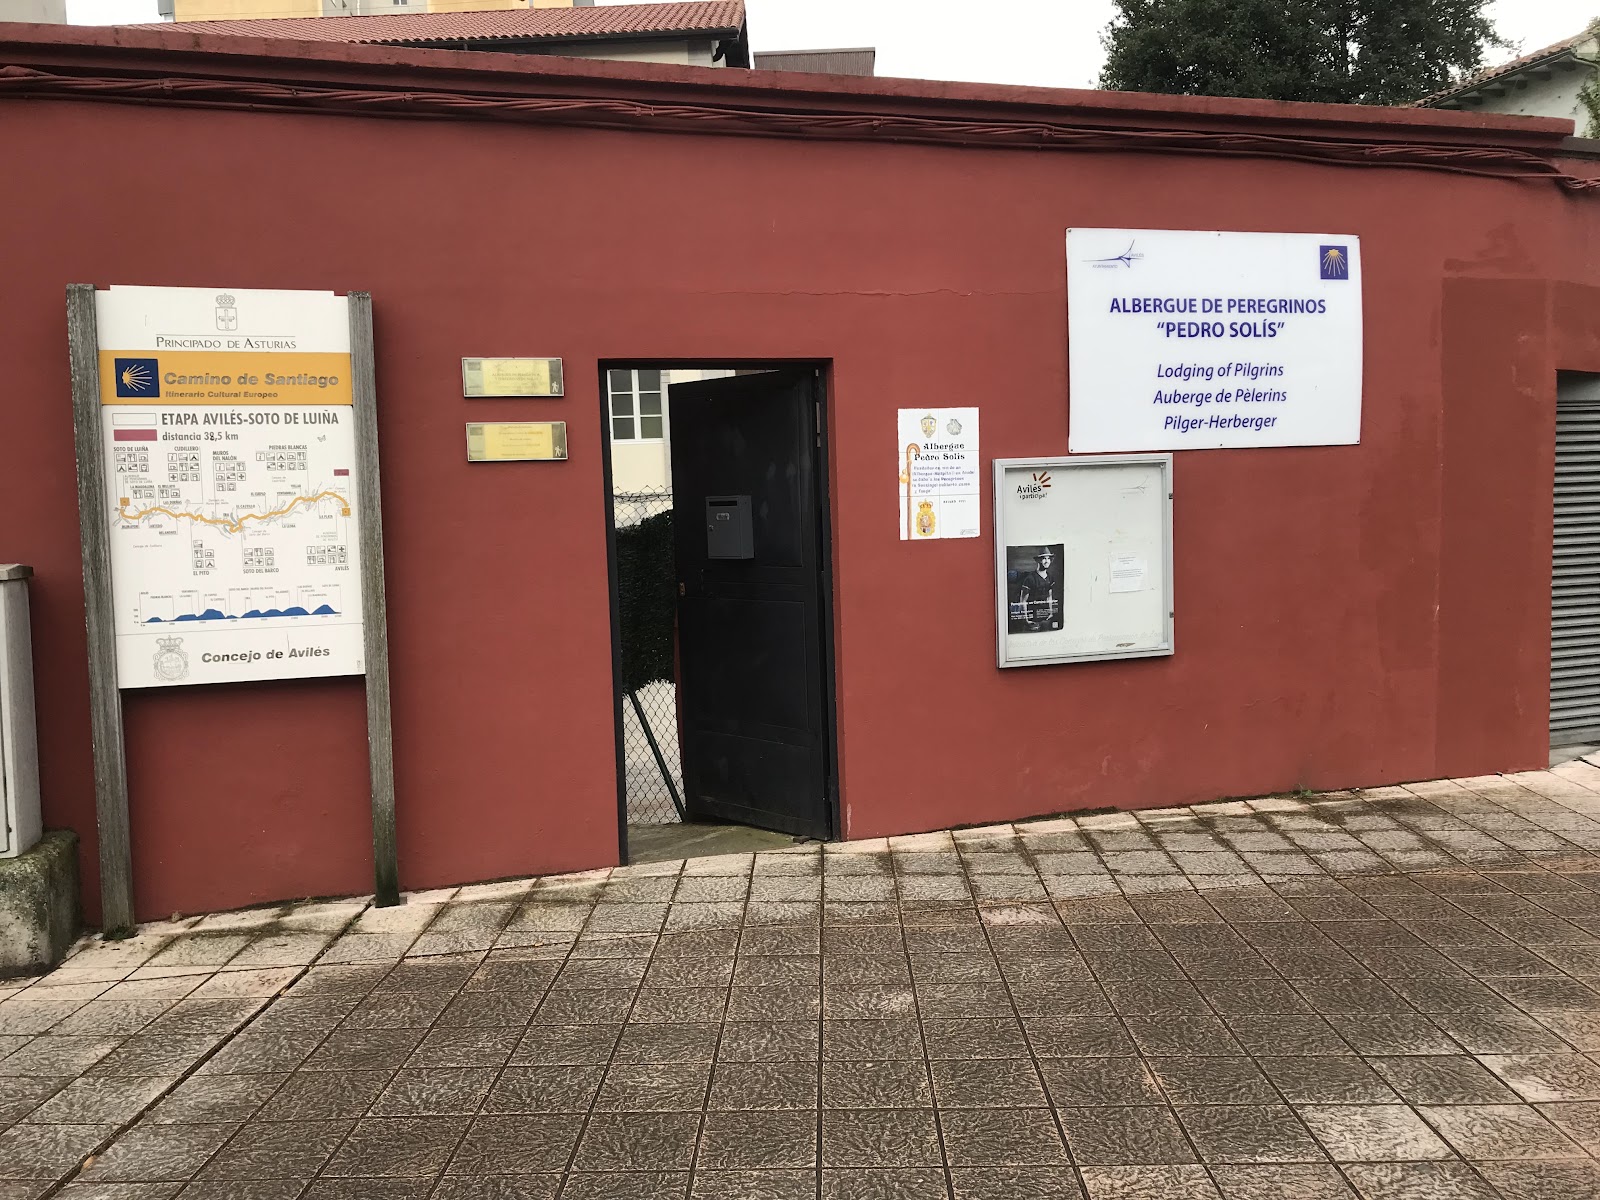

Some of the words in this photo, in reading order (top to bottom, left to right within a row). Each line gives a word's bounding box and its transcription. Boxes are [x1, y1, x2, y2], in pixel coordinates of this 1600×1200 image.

[1110, 297, 1197, 314] ALBERGUE
[1202, 298, 1223, 314] DE
[1228, 299, 1327, 314] PEREGRINOS
[227, 340, 240, 348] DE
[164, 372, 232, 386] Camino
[237, 372, 259, 386] de
[264, 373, 340, 389] Santiago
[1157, 364, 1214, 382] Lodging
[1217, 362, 1233, 377] of
[1234, 362, 1284, 381] Pilgrins
[244, 391, 278, 399] Europeo
[1154, 390, 1212, 407] Auberge
[1216, 388, 1232, 403] de
[1235, 388, 1288, 403] Pèlerins
[162, 412, 199, 426] ETAPA
[203, 409, 280, 426] AVILÉS-SOTO
[284, 412, 300, 425] DE
[303, 410, 340, 425] LUIÑA
[1164, 415, 1278, 434] Pilger-Herberger
[162, 431, 202, 442] distancia
[225, 430, 239, 441] km
[924, 442, 965, 452] Albergue
[914, 452, 940, 461] Pedro
[1016, 483, 1042, 494] Avilés
[202, 650, 262, 664] Concejo
[266, 648, 284, 660] de
[288, 646, 330, 658] Avilés
